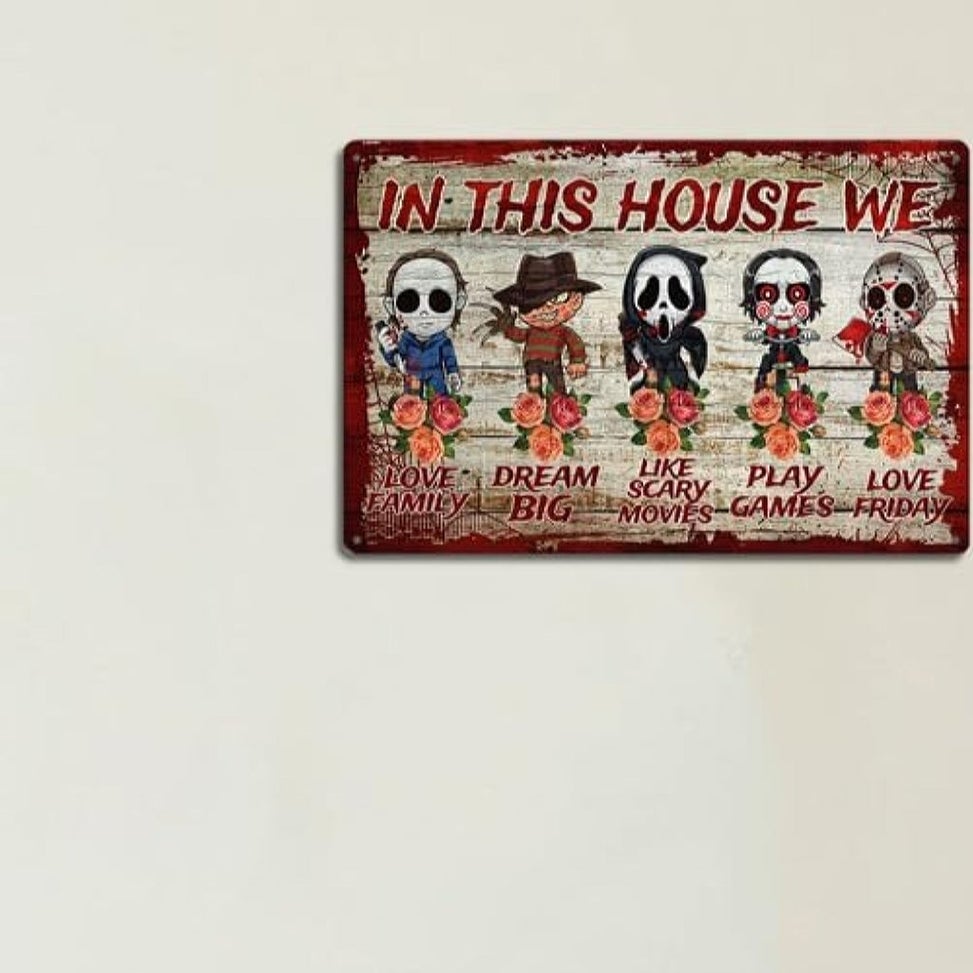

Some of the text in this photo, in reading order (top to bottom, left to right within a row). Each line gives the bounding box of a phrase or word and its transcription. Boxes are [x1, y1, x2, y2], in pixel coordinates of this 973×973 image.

[379, 177, 939, 233] IN THIS HOUSE WE
[384, 466, 458, 489] LOVE
[492, 465, 600, 492] DREAM
[639, 458, 695, 478] LIKE
[746, 465, 825, 494] PLAY
[866, 469, 937, 491] LOVE
[627, 480, 711, 501] SCARY
[364, 492, 470, 518] FAMILY
[508, 495, 573, 522] BIG
[617, 504, 715, 525] MOVIES
[729, 495, 836, 518] GAMES
[852, 497, 952, 525] FRIDAY
